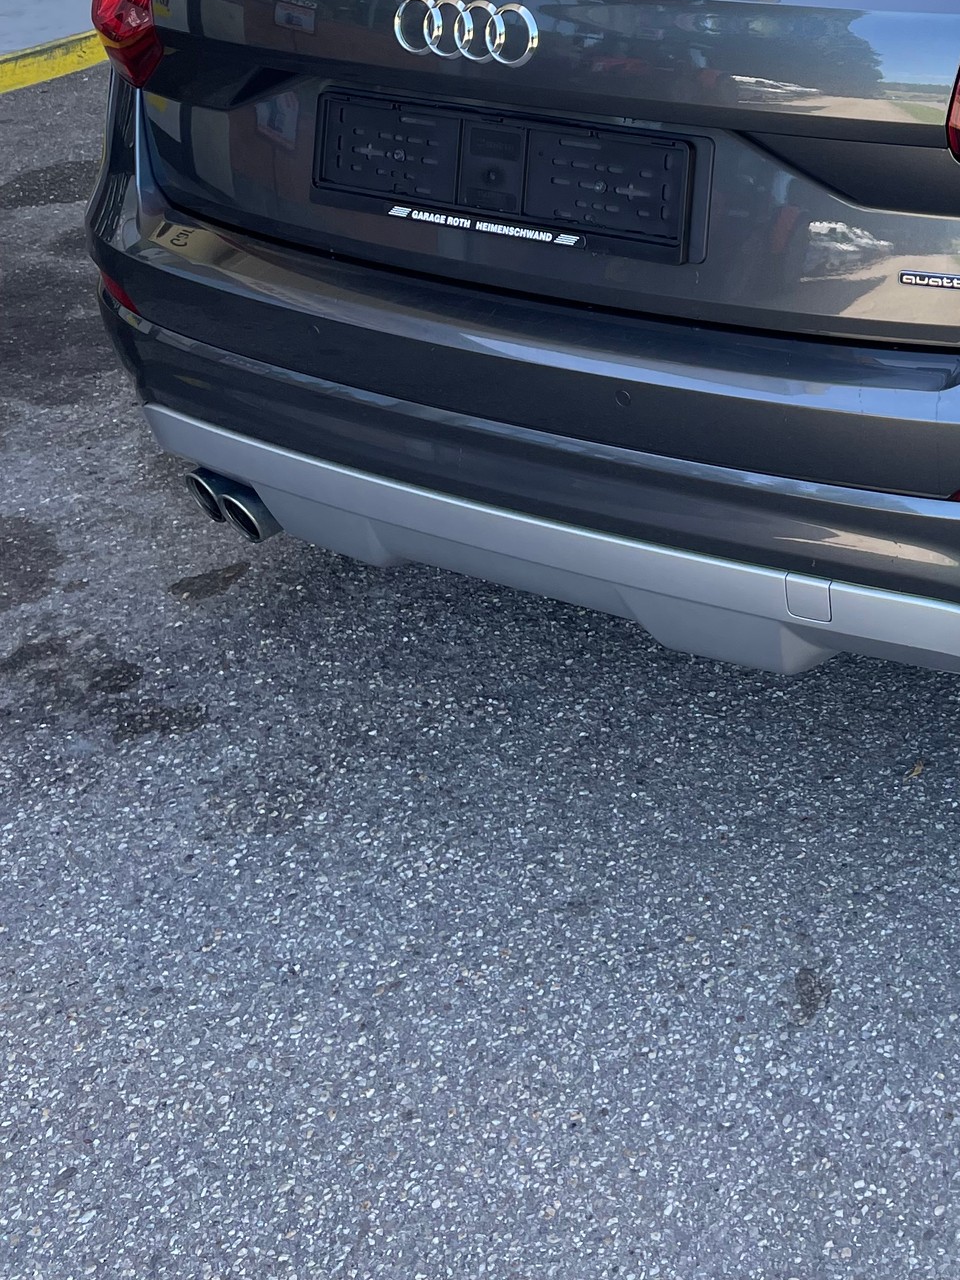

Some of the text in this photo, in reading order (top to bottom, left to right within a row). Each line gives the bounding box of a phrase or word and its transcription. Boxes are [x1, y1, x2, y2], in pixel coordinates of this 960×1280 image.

[411, 210, 553, 242] GARAGE ROTH HEIMENSCHWAND
